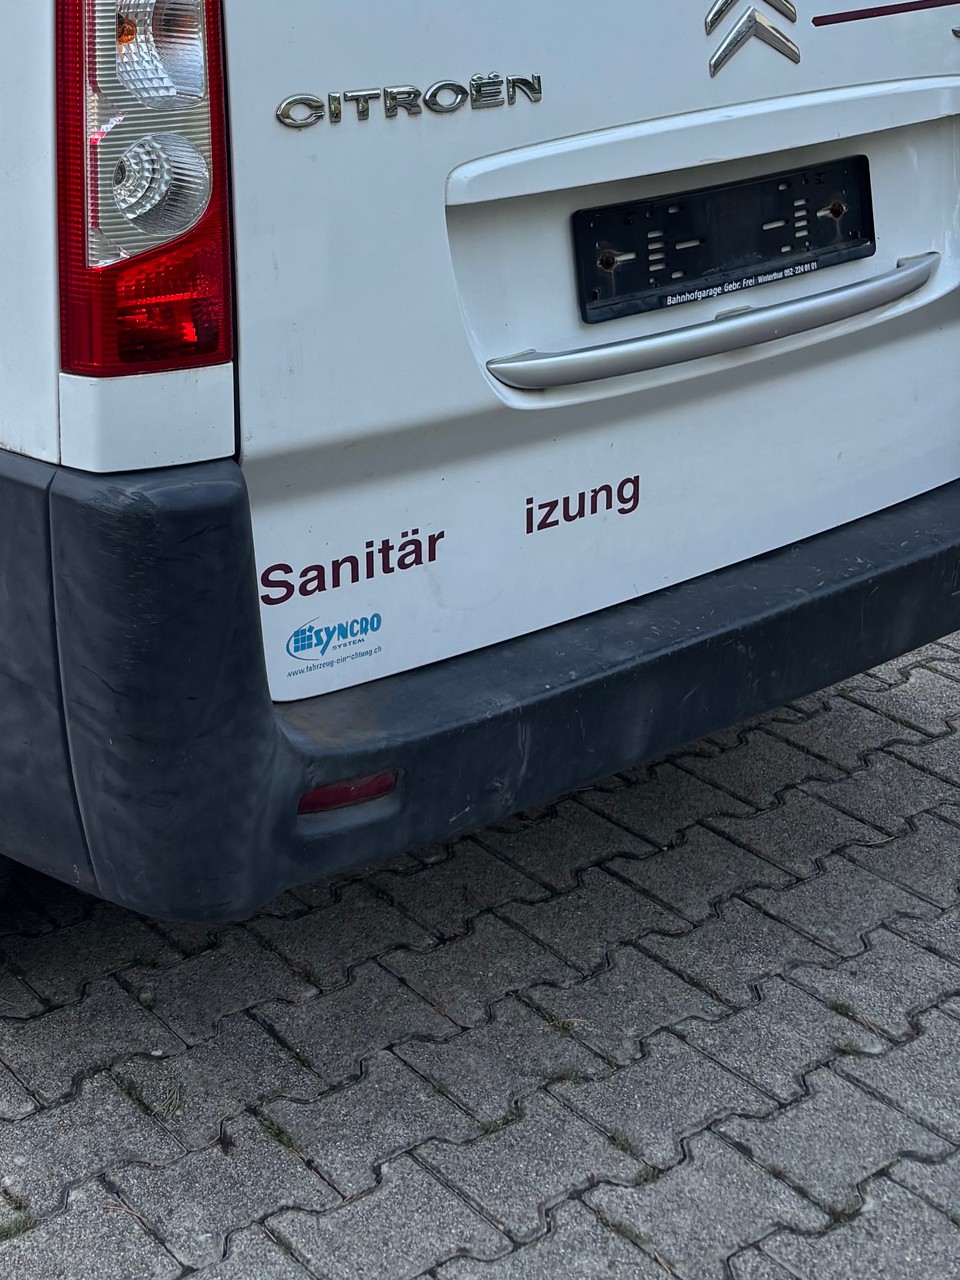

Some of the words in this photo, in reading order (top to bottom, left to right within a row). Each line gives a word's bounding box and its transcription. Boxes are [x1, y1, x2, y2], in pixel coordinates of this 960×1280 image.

[276, 71, 543, 128] CITROËN
[667, 285, 722, 306] Bahnhofgarage
[724, 281, 741, 293] Gebr.
[742, 276, 755, 288] Frei
[757, 269, 784, 284] Winterthur
[260, 527, 445, 606] Sanitär
[525, 474, 641, 534] izung
[332, 638, 365, 651] SYSTEM
